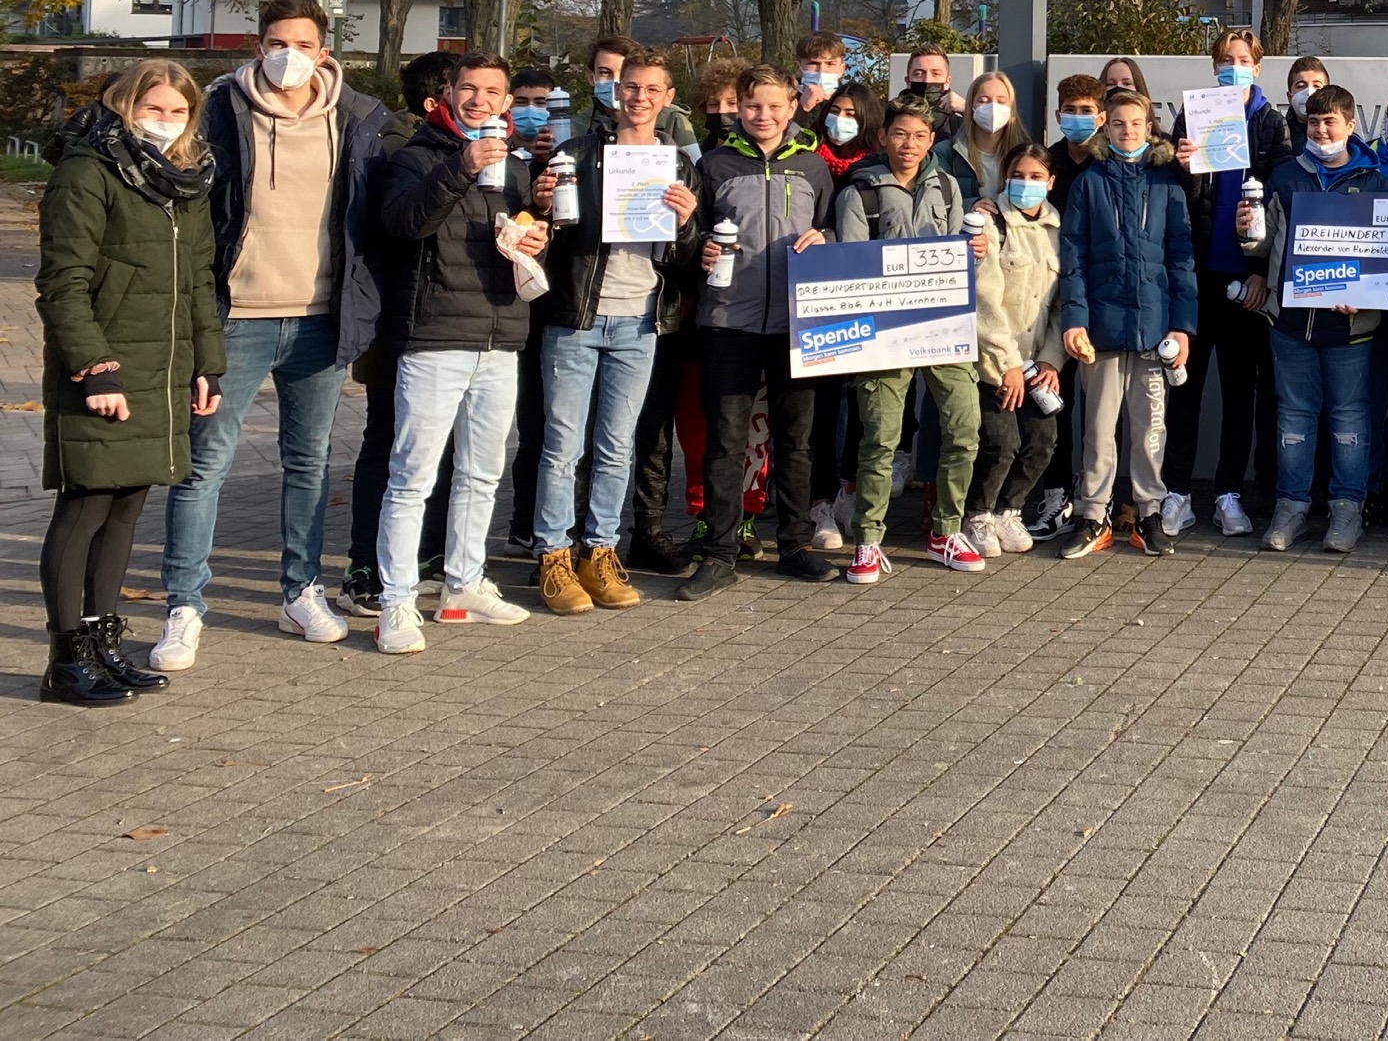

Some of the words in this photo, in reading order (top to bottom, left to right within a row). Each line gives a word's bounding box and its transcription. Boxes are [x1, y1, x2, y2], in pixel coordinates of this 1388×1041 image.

[608, 167, 636, 175] Urkunde
[1300, 227, 1386, 240] DREIHUNDERT
[1296, 243, 1335, 253] Alexander
[886, 263, 905, 272] EUR
[1295, 263, 1357, 286] Spende
[802, 304, 836, 314] Klasse
[899, 295, 948, 307] Viernheim
[801, 321, 871, 351] Spende
[909, 345, 952, 356] Volksbank
[1146, 366, 1164, 453] PlayStation
